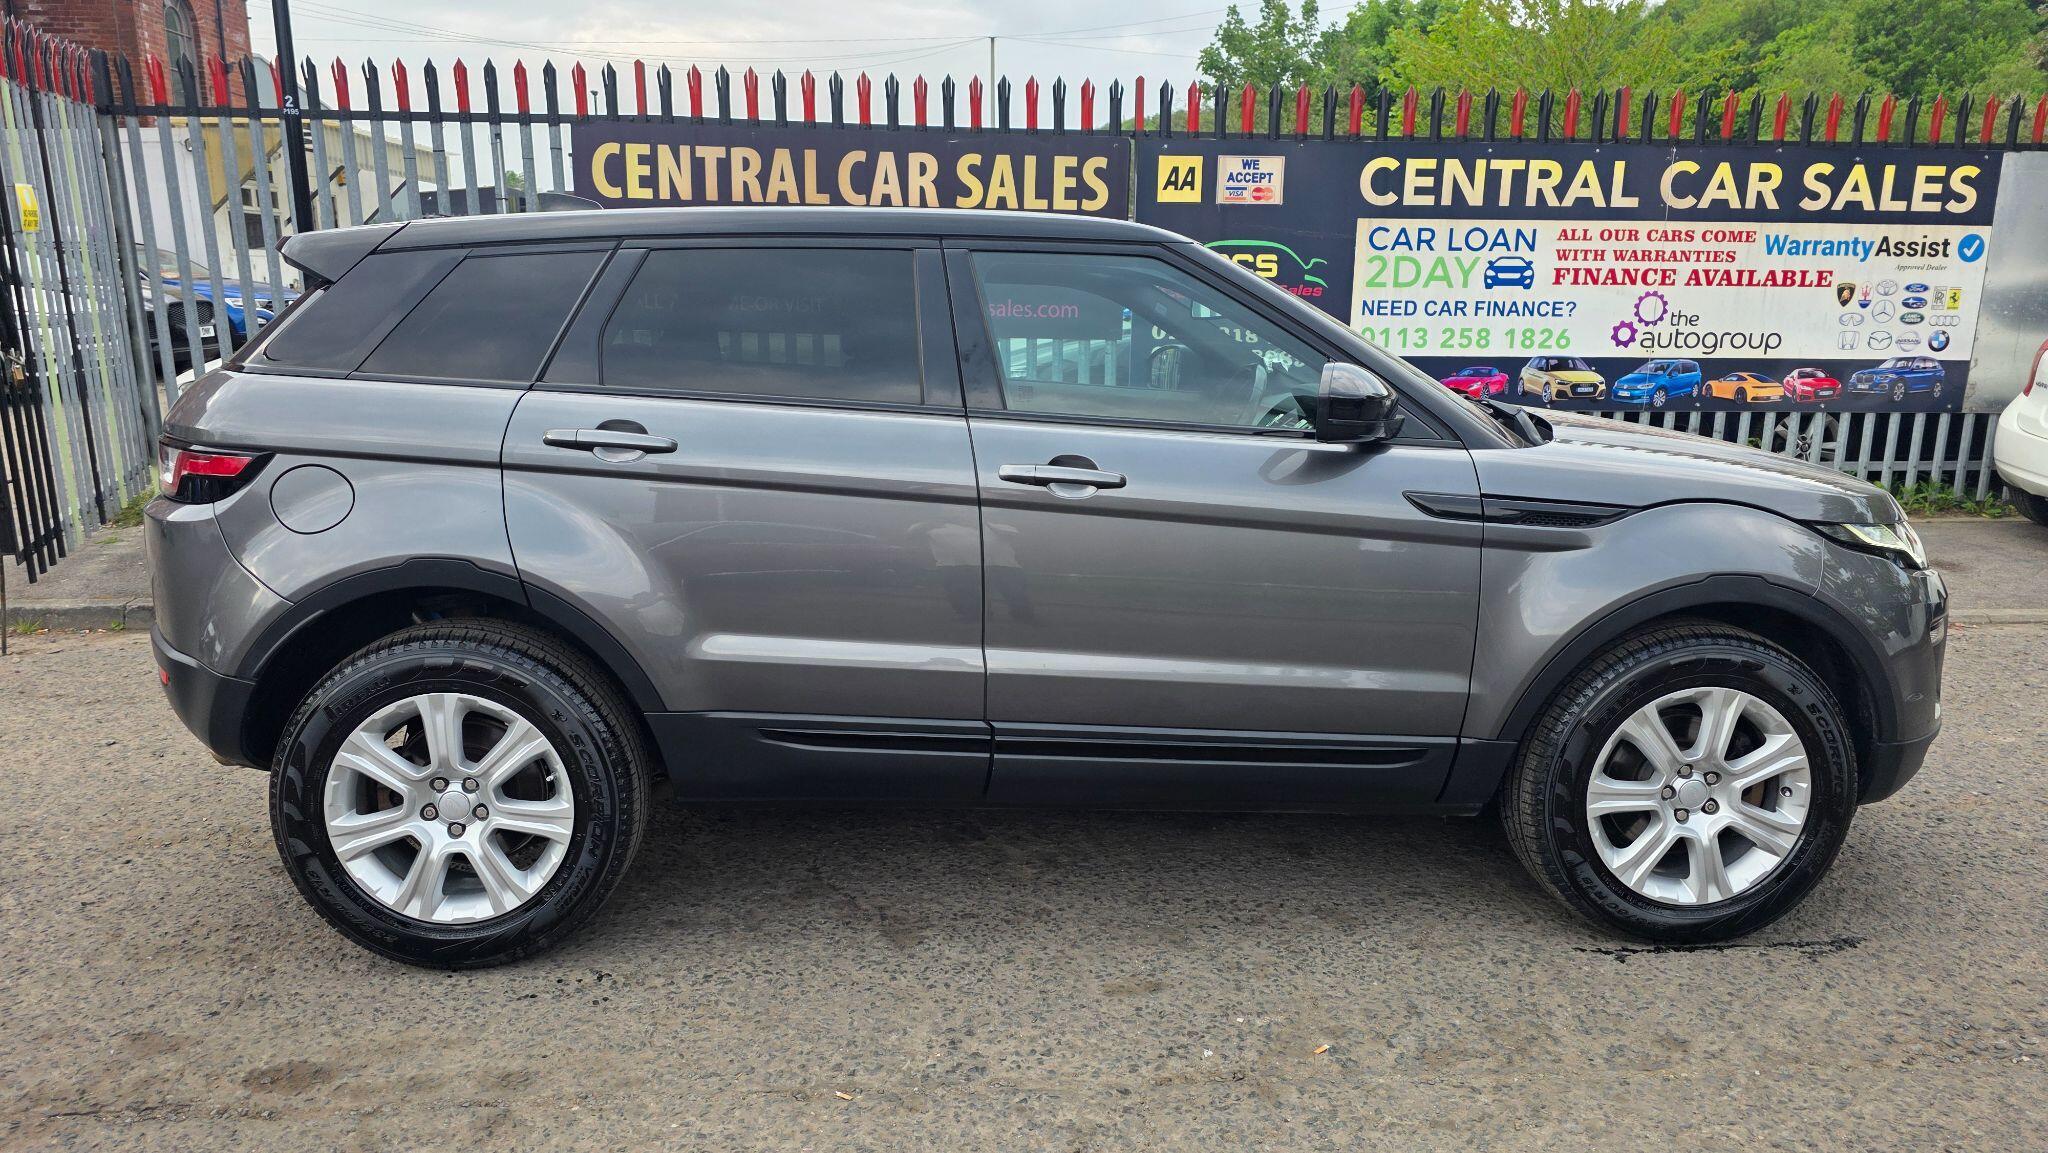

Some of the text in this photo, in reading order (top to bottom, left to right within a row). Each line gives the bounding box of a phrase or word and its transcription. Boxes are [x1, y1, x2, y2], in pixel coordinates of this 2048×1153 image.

[284, 95, 294, 108] 2
[1242, 159, 1260, 170] WE
[591, 142, 1109, 211] CENTRAL CAR SALES
[1162, 166, 1196, 191] AA
[1227, 172, 1273, 183] ACCEPT
[1360, 157, 1982, 214] CENTRAL CAR SALES
[1369, 226, 1537, 252] CAR LOAN
[1557, 229, 1757, 243] ALL OUR CARS COME
[1556, 249, 1736, 262] WITH WARRANTIES
[1365, 254, 1481, 288] 2DAY
[1552, 268, 1833, 287] FINANCE AVAILABLE
[1361, 300, 1577, 317] NEED CAR FINANCE?
[1670, 310, 1700, 326] the
[1440, 327, 1491, 349] 258
[1505, 328, 1571, 350] 1826
[1640, 329, 1782, 355] autogroup
